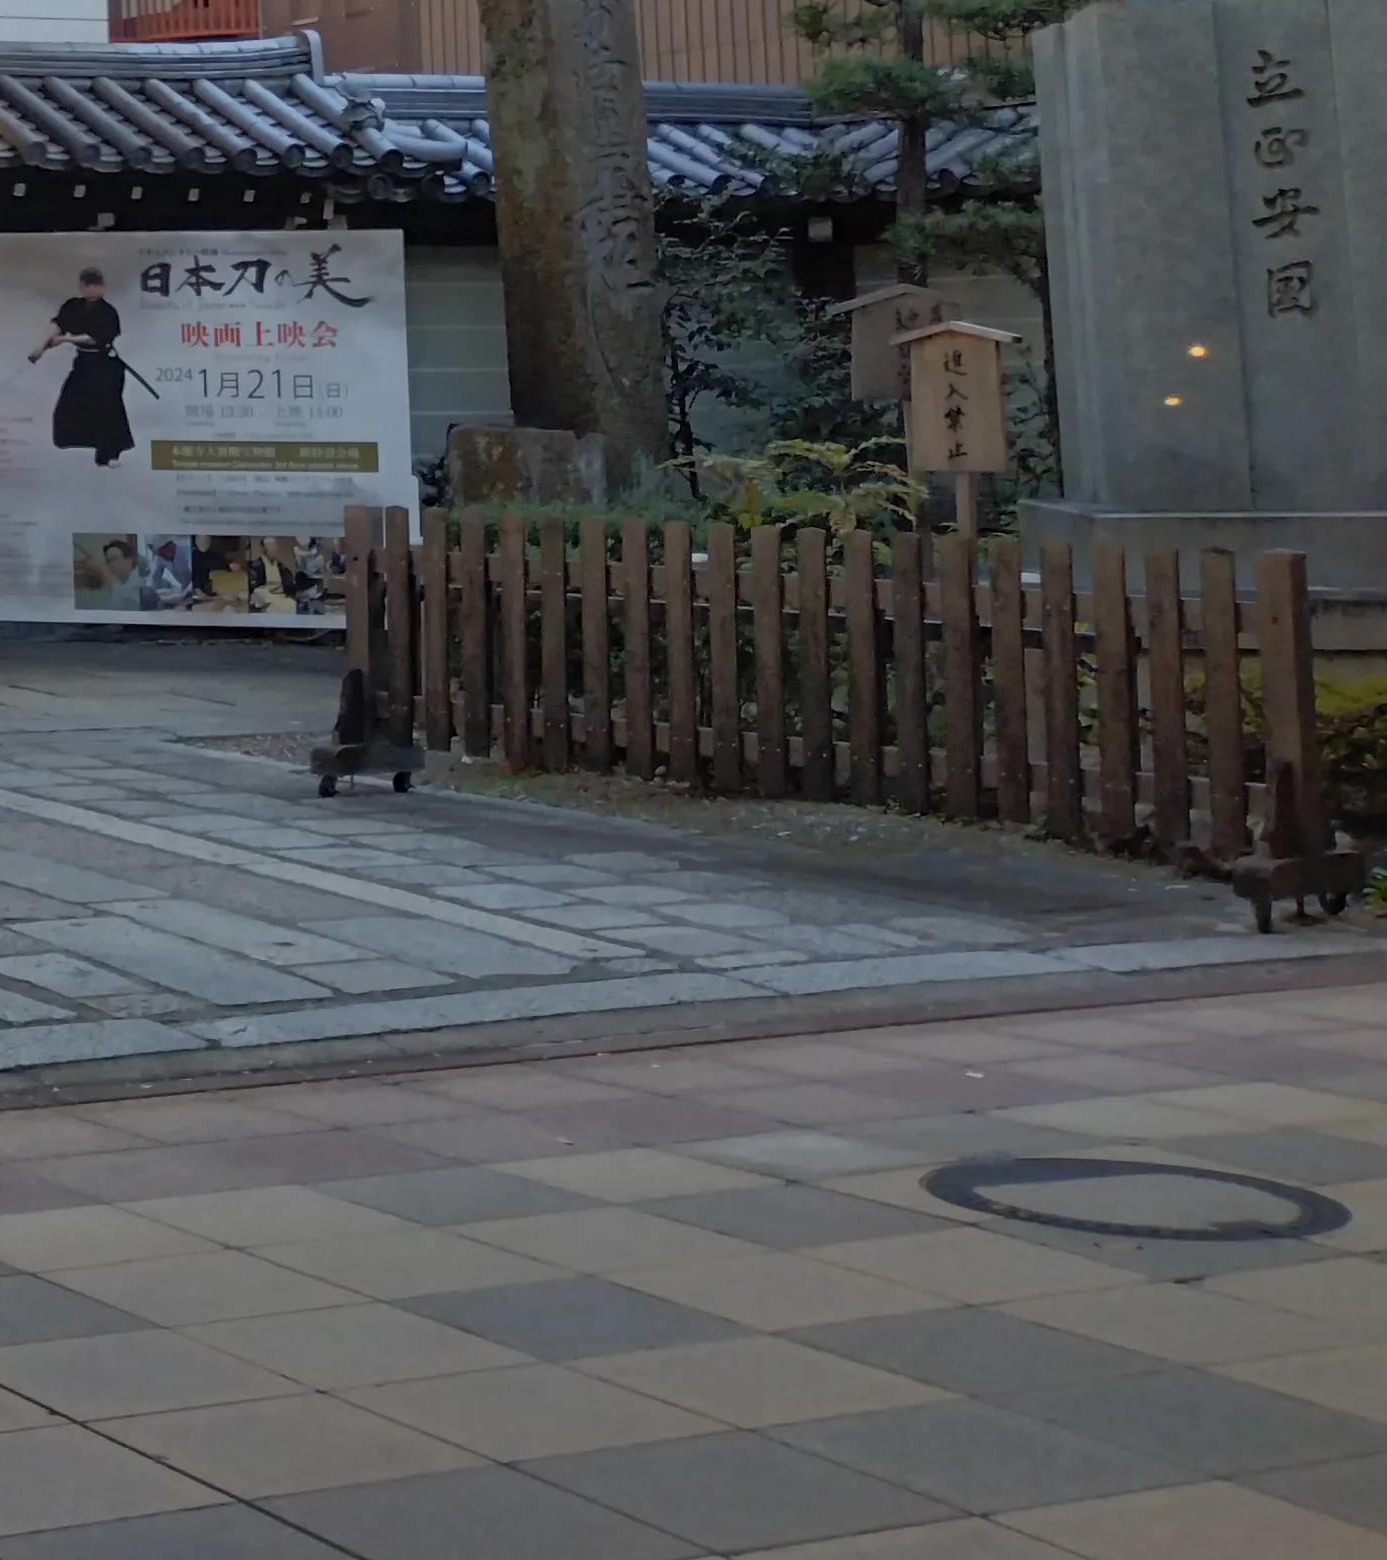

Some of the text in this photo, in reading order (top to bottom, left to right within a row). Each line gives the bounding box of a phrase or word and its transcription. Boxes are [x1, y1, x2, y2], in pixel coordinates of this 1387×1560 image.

[139, 243, 374, 308] 日本刀の美
[180, 320, 340, 348] 映画上映会
[155, 368, 193, 383] 2024
[943, 349, 970, 460] 進入禁止
